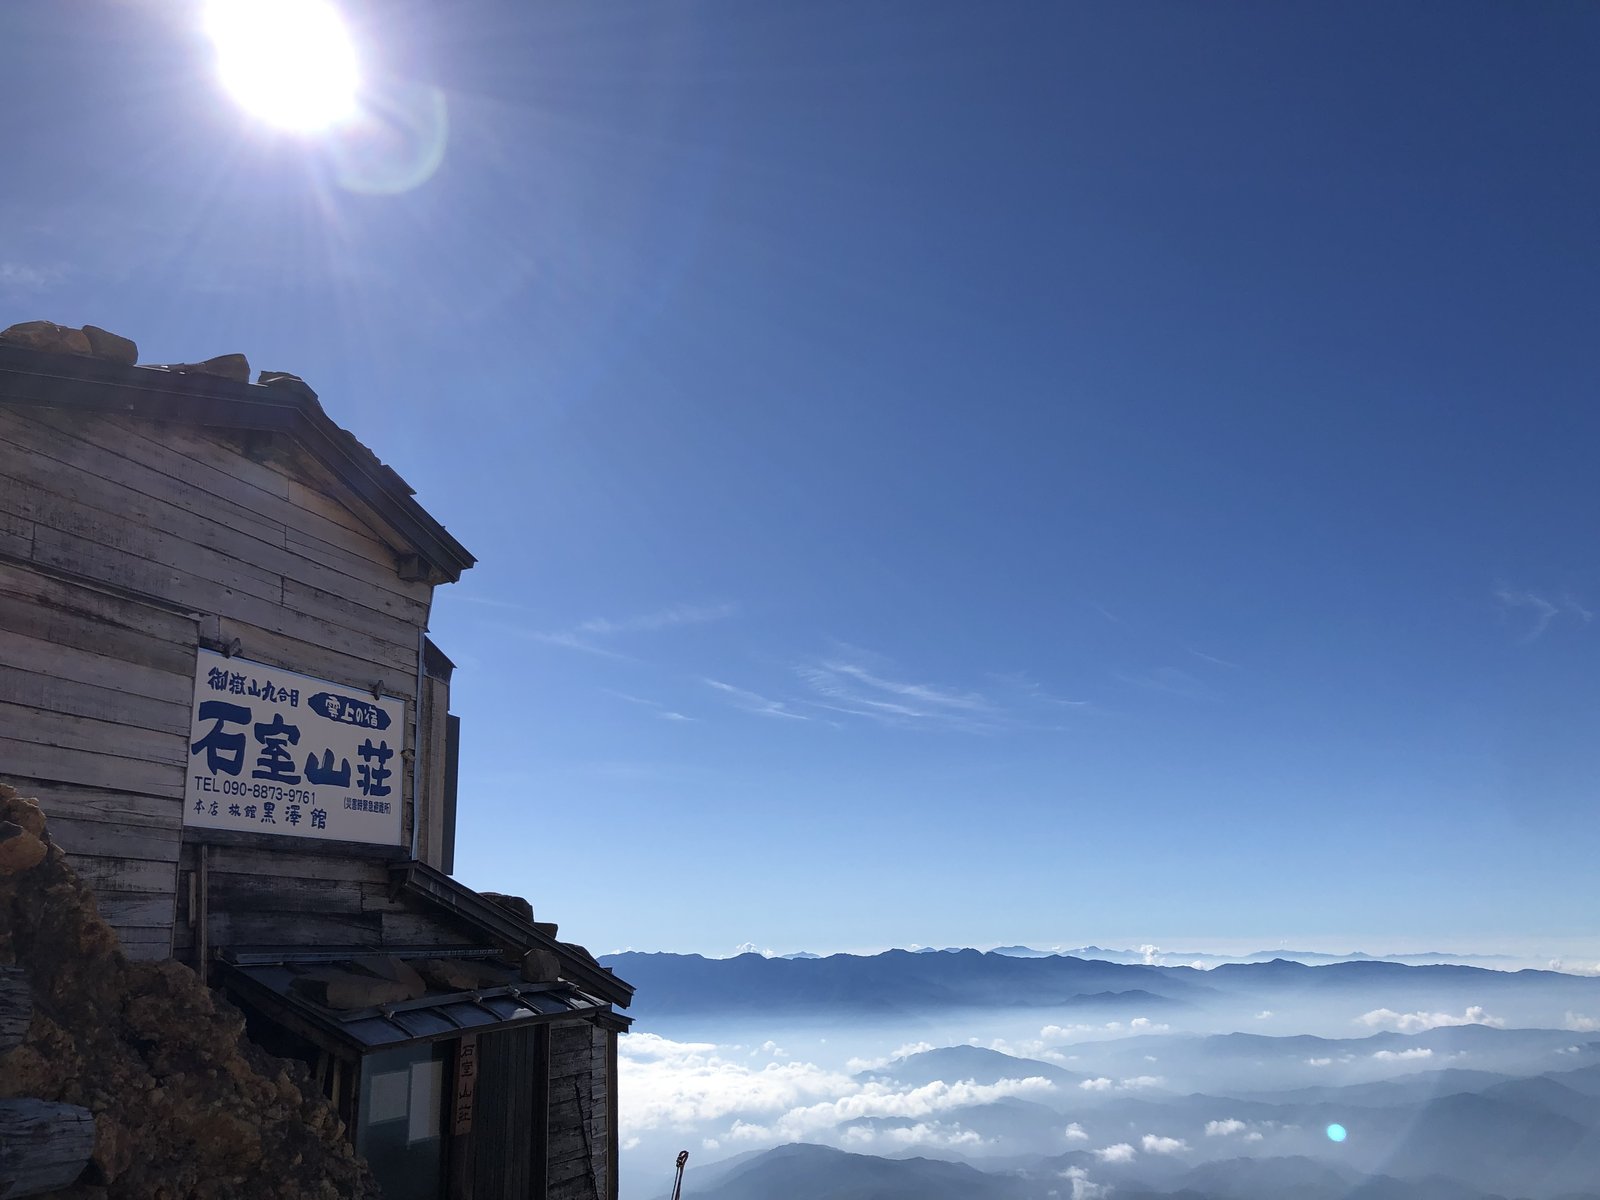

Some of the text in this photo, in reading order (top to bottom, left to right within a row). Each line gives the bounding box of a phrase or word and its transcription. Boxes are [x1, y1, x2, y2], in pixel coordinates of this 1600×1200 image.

[207, 666, 300, 707] 御嶽山九合目
[326, 695, 378, 727] 雲上の宿
[191, 700, 394, 796] 石室山荘
[193, 799, 219, 816] 本店
[194, 776, 315, 805] TEL 090-8873-9761
[457, 1044, 475, 1124] 石室山荘
